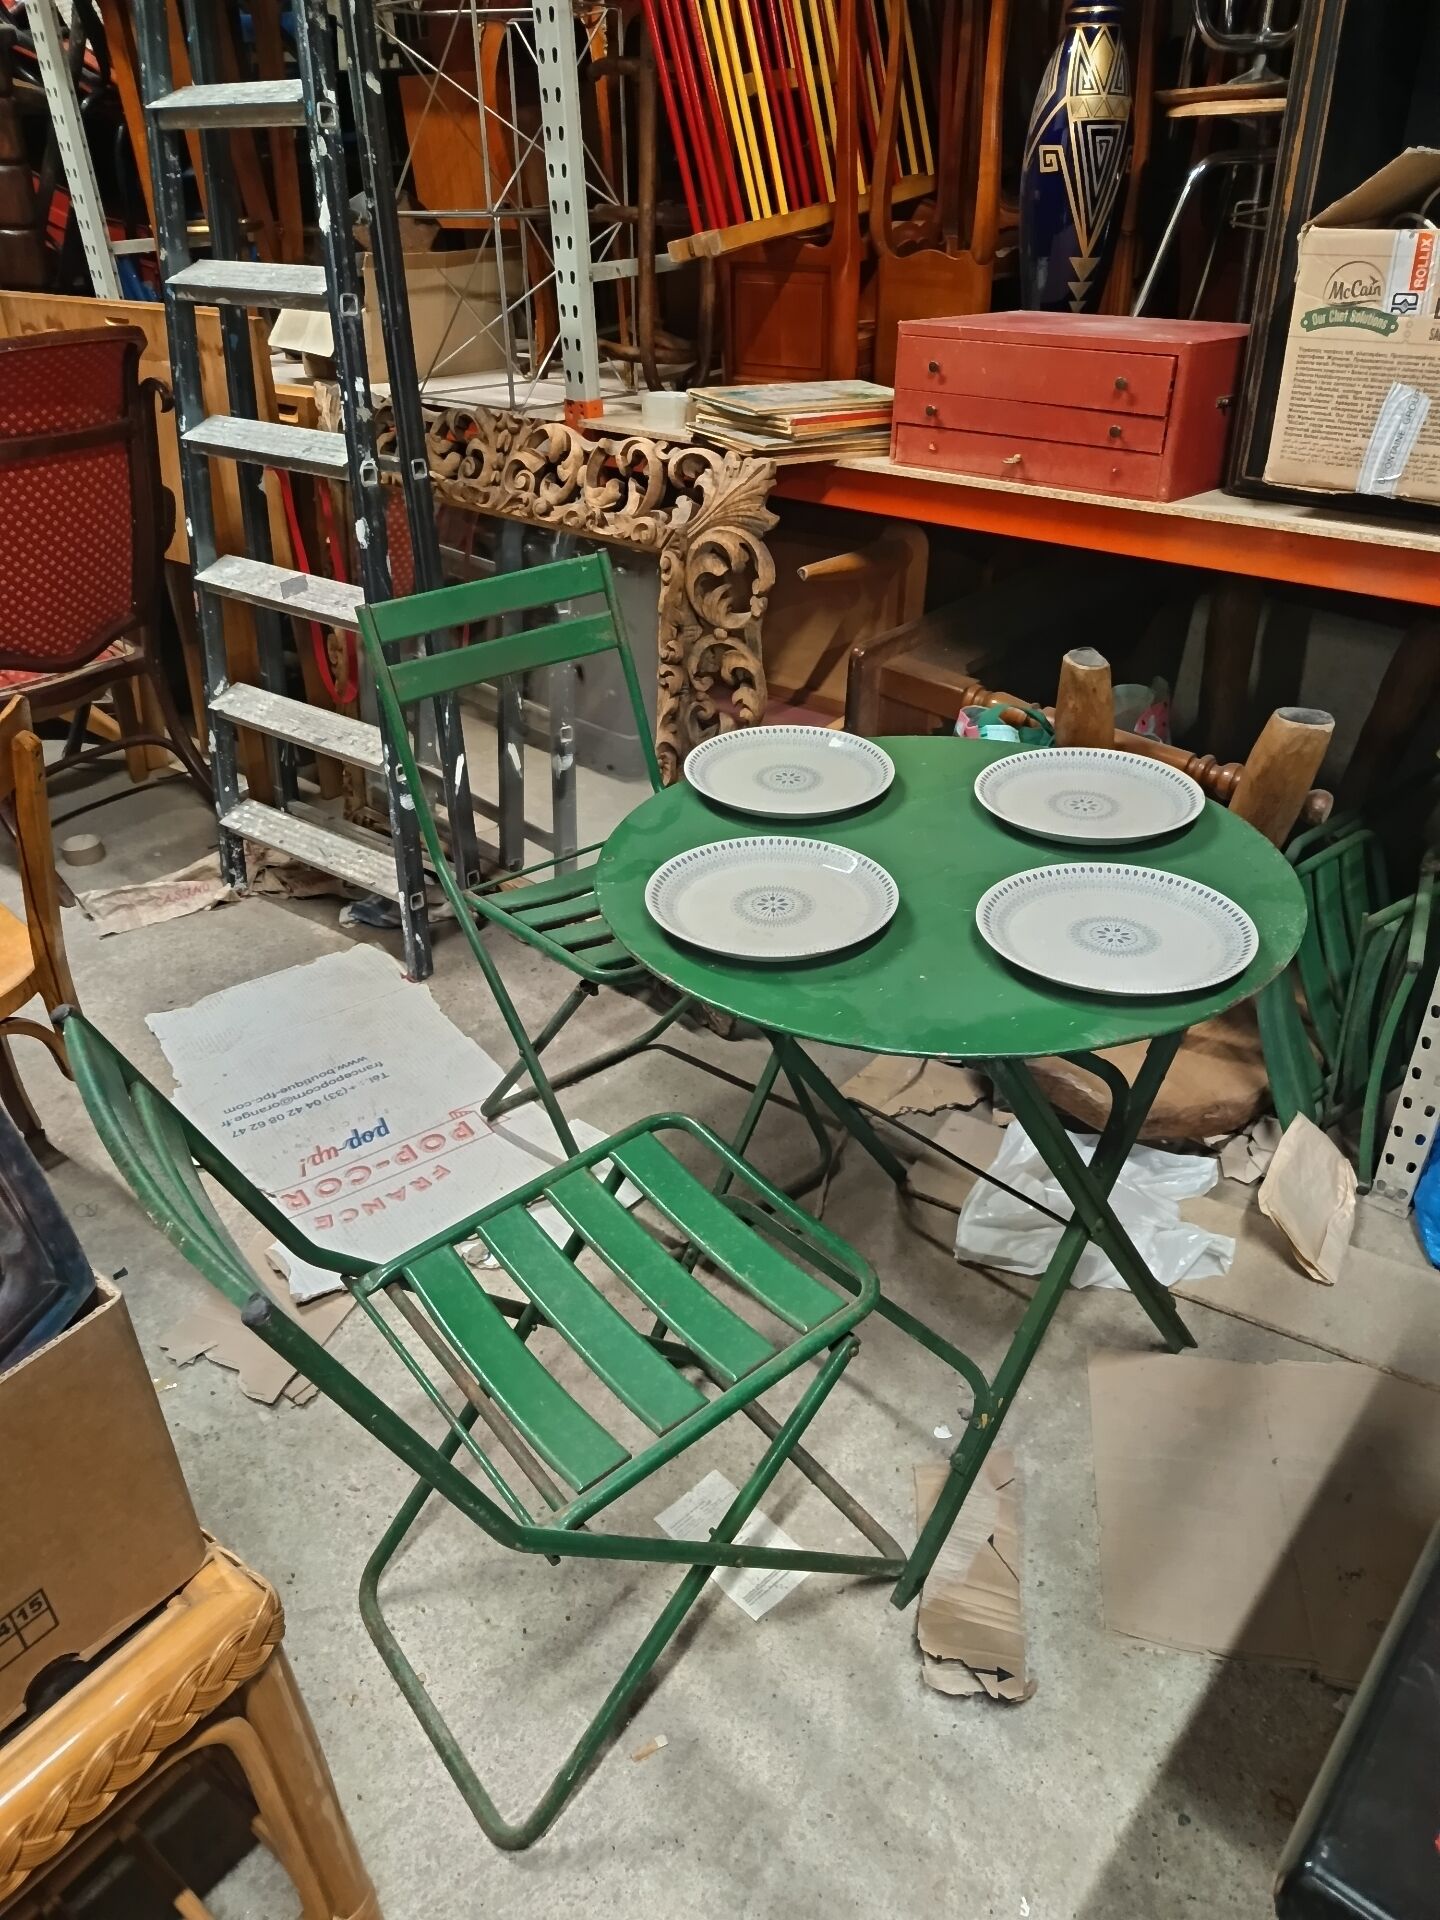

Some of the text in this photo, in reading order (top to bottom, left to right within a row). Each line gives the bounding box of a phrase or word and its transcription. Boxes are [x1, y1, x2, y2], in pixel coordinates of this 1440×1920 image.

[1413, 238, 1433, 289] ROLLIX
[1329, 276, 1382, 301] McCain
[1311, 308, 1389, 330] Our Chef Solutions
[220, 1061, 384, 1128] francepopcorn@orange.fr
[222, 1056, 368, 1115] www.boutique-fpc.com
[288, 1106, 303, 1118] 42
[305, 1098, 323, 1110] 04
[249, 1120, 267, 1132] 62
[268, 1113, 286, 1125] 08
[231, 1127, 247, 1139] 47
[299, 1116, 391, 1178] pop-up!
[313, 1164, 451, 1230] FRANCE
[16, 1596, 43, 1620] 15
